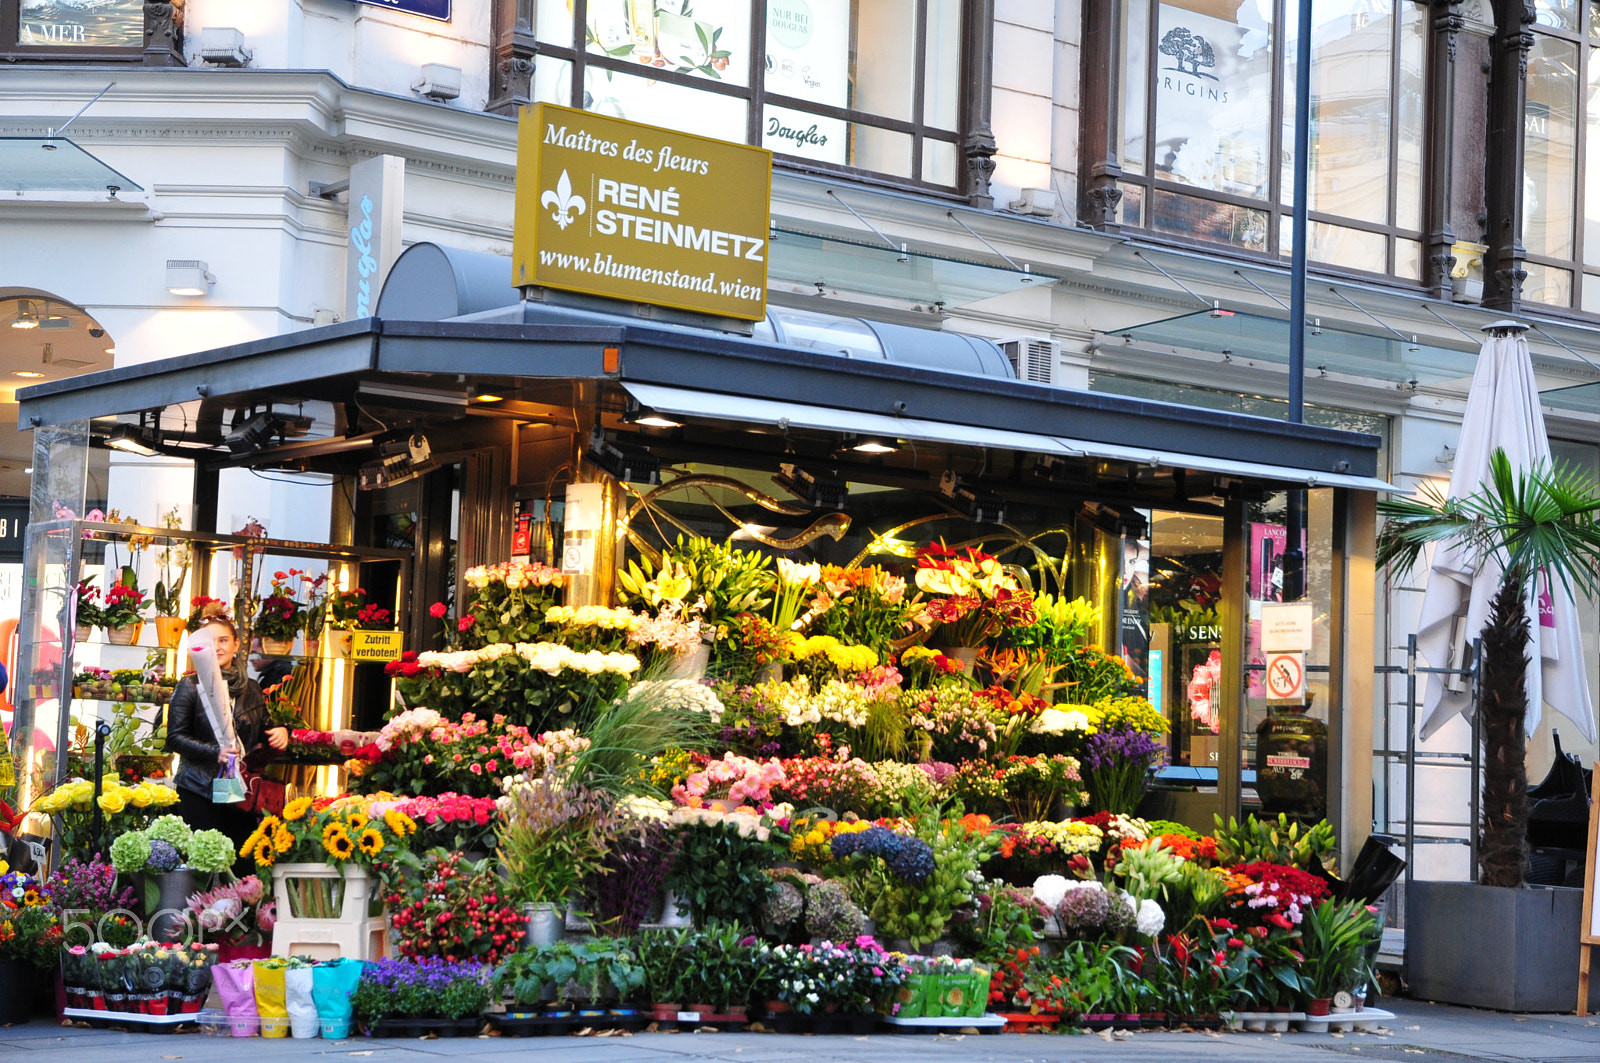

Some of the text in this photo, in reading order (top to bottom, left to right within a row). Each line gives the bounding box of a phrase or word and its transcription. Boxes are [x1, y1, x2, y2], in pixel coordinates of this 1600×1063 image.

[772, 18, 808, 34] DOUGLAS
[773, 7, 809, 25] NUR BEI
[41, 24, 86, 43] MER
[1156, 76, 1229, 104] RIGINS
[766, 117, 828, 148] Douglas
[543, 123, 709, 176] Maîtres des fleurs
[598, 178, 680, 217] RENÉ
[595, 209, 765, 262] STEINMETZ
[539, 249, 762, 301] www.blumenstand.wien
[1264, 528, 1287, 537] LANCÔ
[365, 634, 391, 645] Zutritt
[356, 647, 398, 658] verboten!
